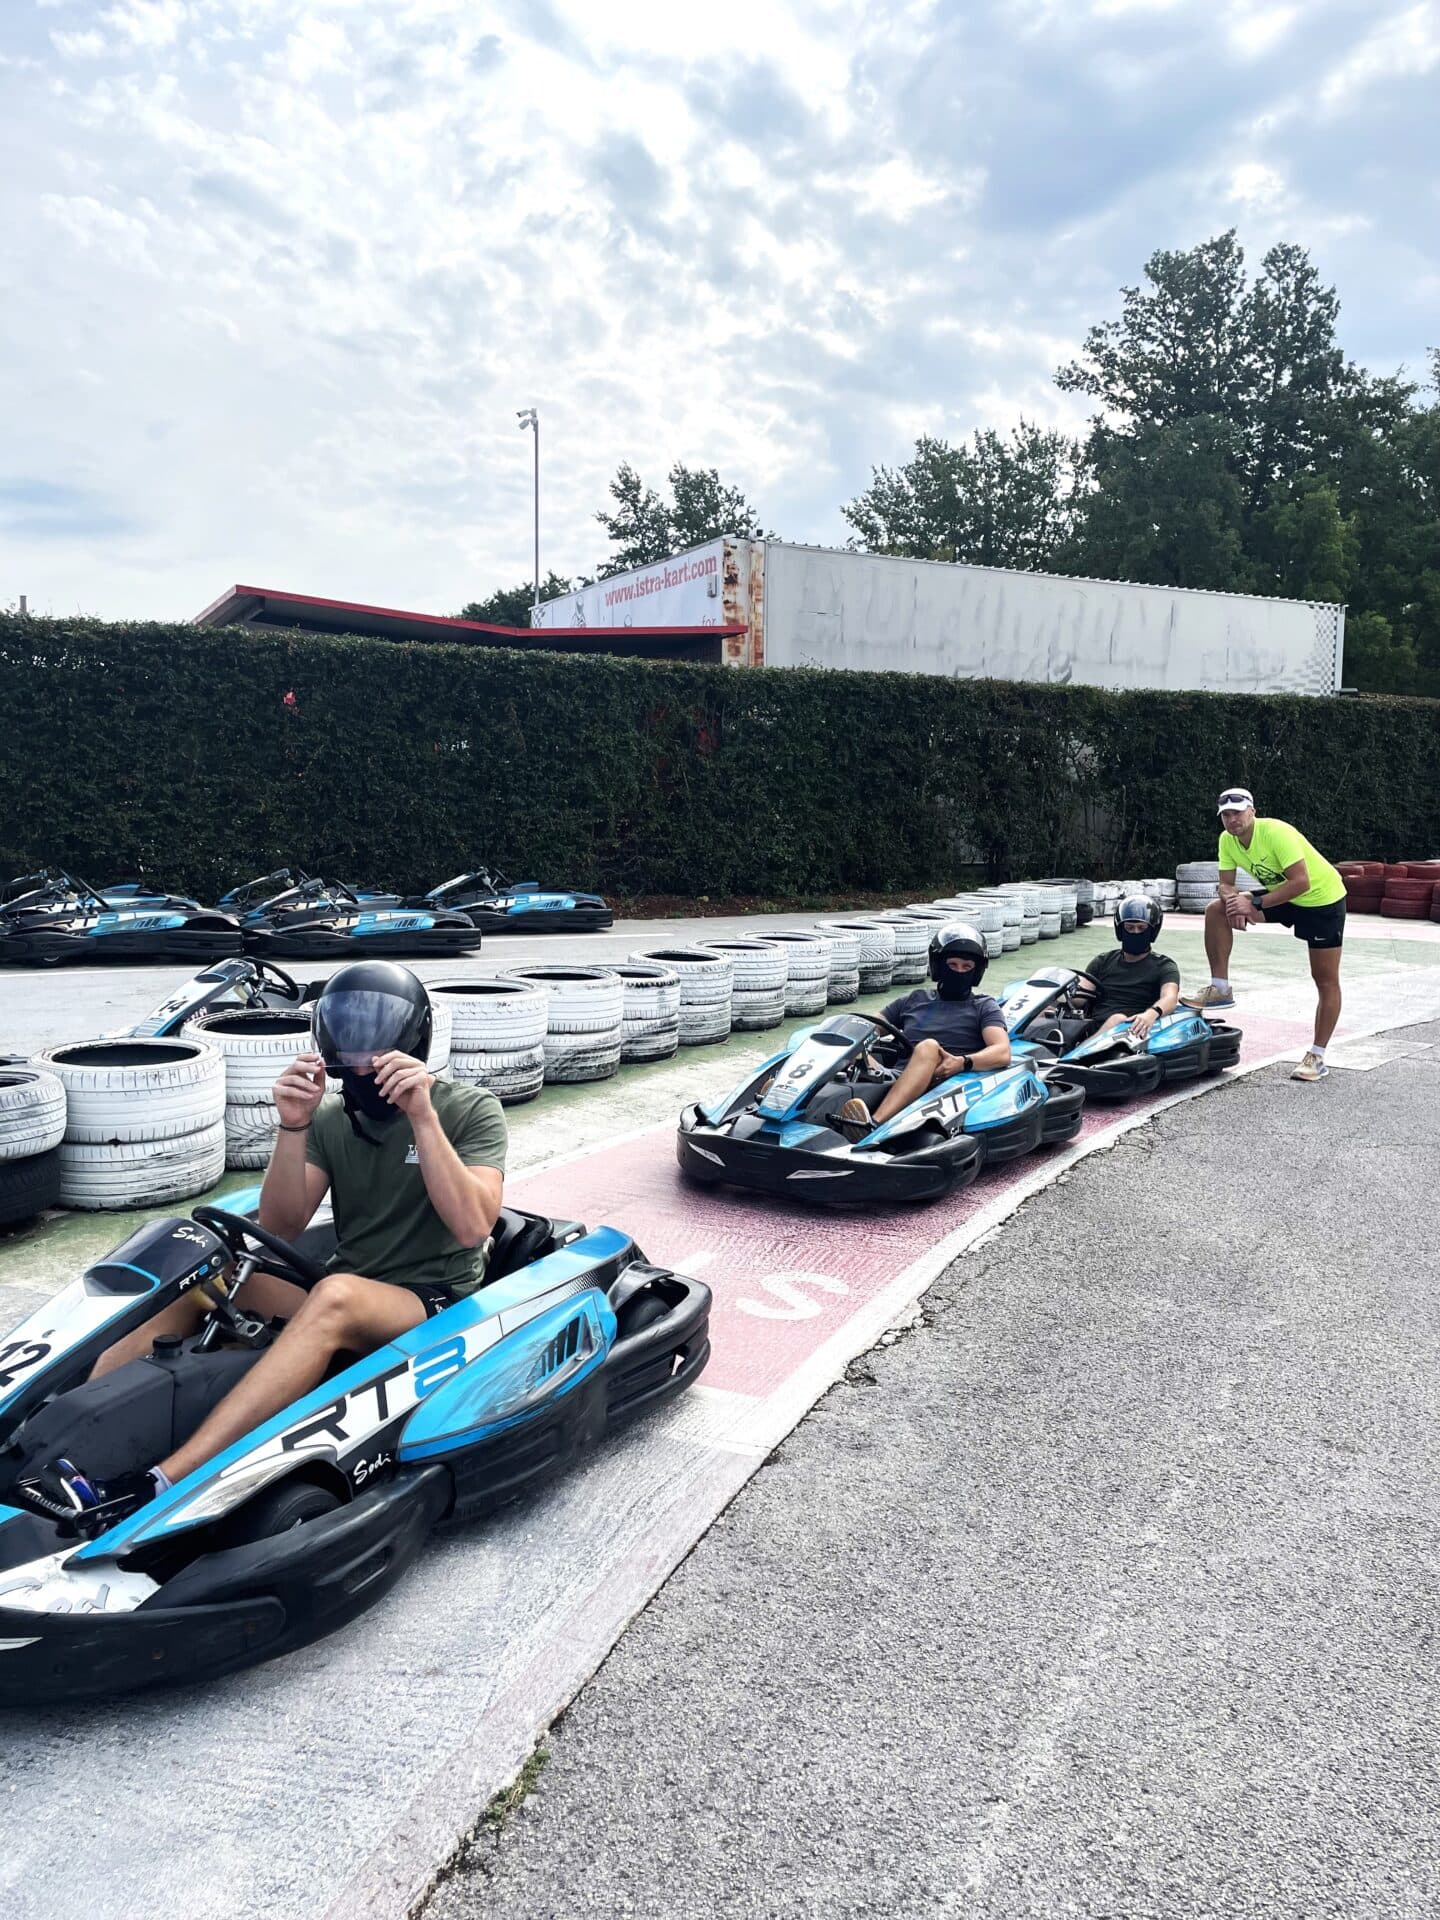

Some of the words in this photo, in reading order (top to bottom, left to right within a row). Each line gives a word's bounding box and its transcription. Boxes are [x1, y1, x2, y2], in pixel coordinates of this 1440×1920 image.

[605, 556, 718, 607] www.istra-kart.com
[158, 999, 189, 1014] 14
[1009, 998, 1030, 1011] 3
[788, 1063, 813, 1079] 8
[921, 1079, 984, 1118] RT8
[179, 1263, 209, 1290] RT8
[0, 1339, 52, 1388] 12
[280, 1335, 468, 1453] RT8
[352, 1452, 393, 1485] Sodi
